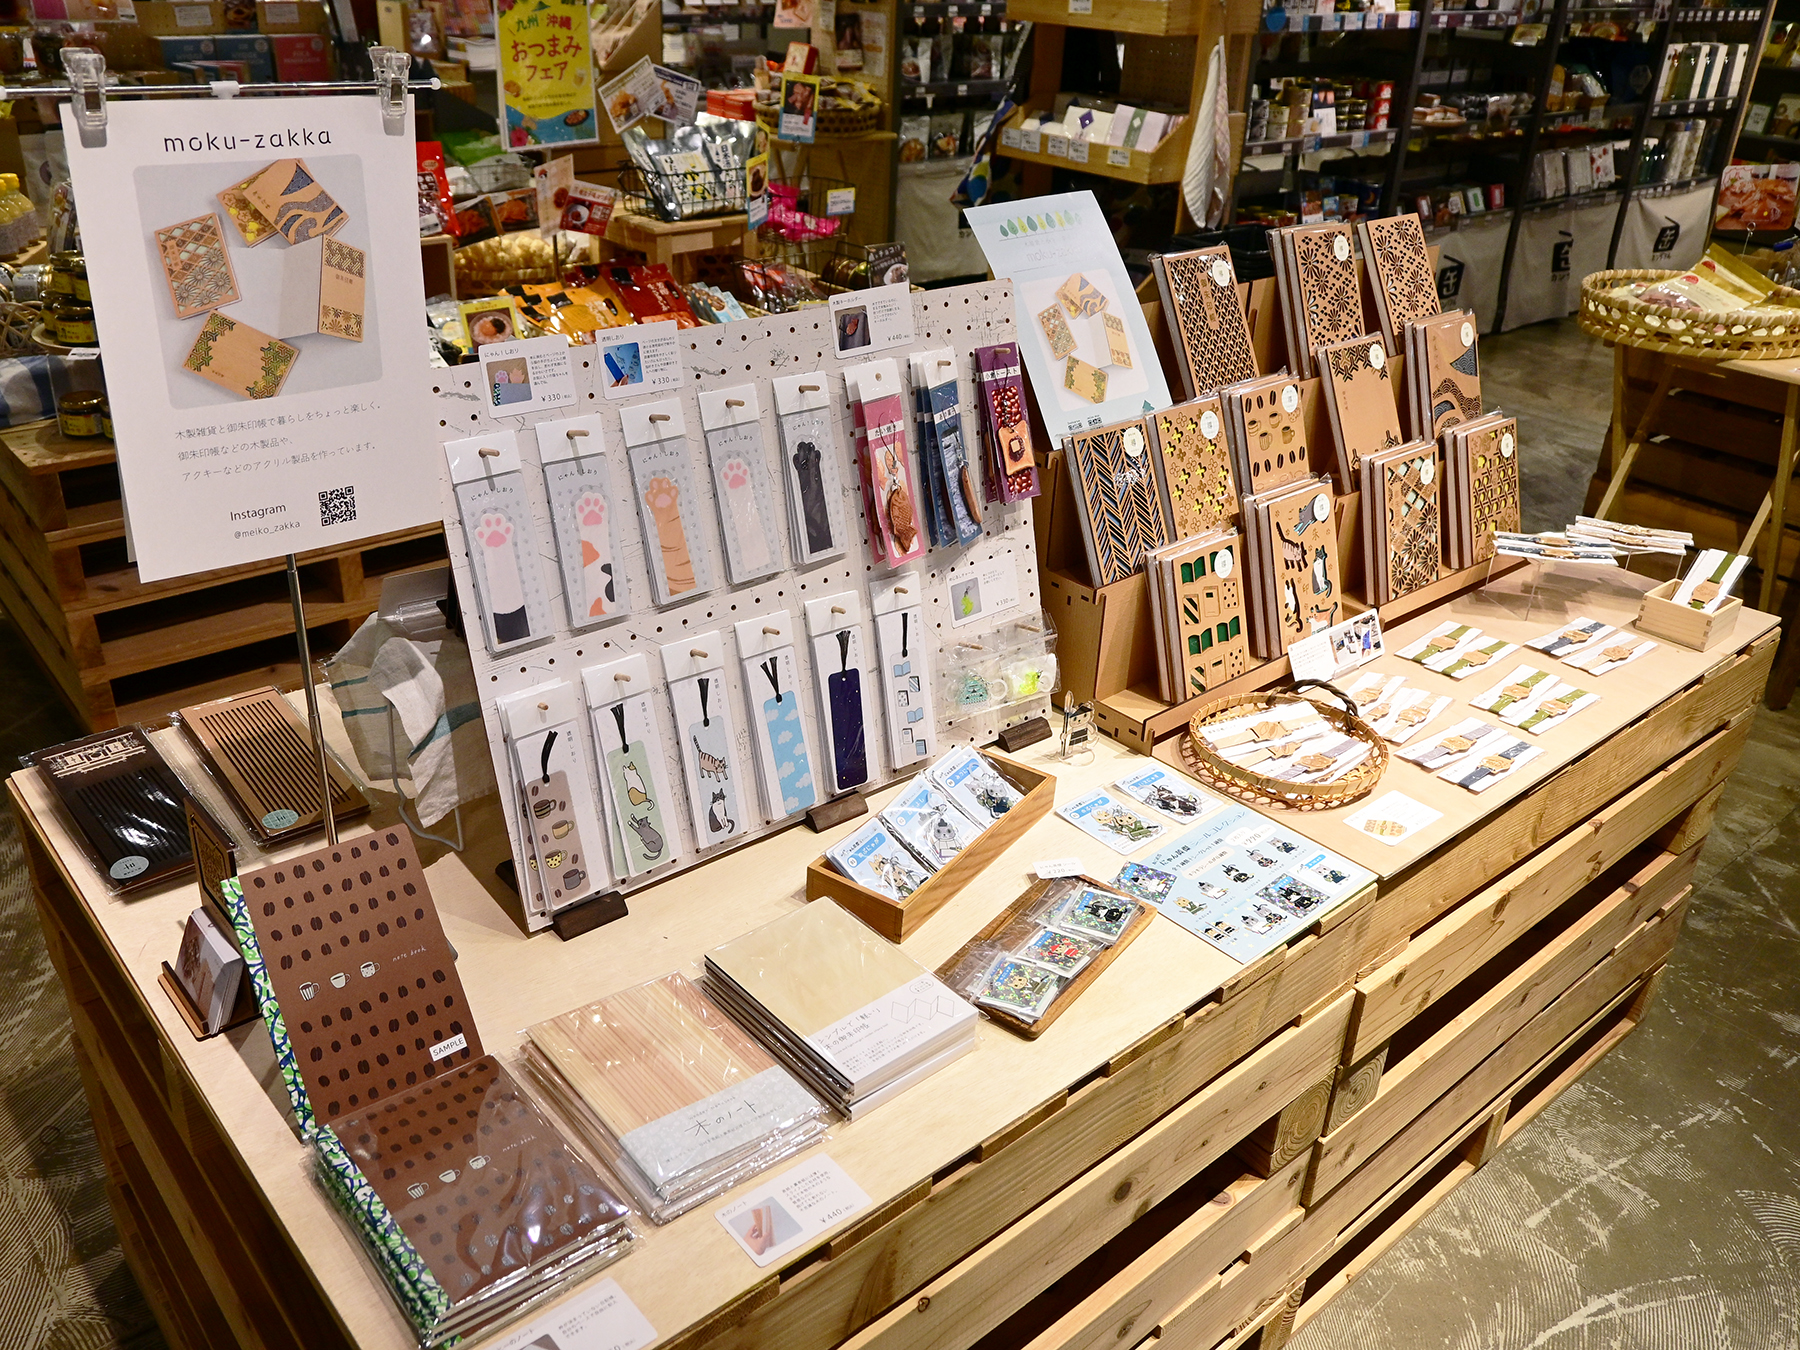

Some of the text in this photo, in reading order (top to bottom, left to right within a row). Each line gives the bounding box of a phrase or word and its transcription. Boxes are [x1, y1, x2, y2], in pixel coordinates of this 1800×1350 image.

[516, 12, 572, 32] 九州 沖縄
[511, 34, 582, 62] おつまみ
[525, 60, 568, 82] フェア
[164, 127, 332, 153] moku-zakka
[483, 347, 520, 358] にゃん！しおり
[174, 400, 382, 441] 木製雑貨と御朱印帳で暮らしをちょっと楽しく。
[177, 436, 294, 462] 御朱印帳などの木製品や、
[181, 441, 376, 482] アクキーなどのアクリル製品を作っています。
[229, 502, 287, 523] Instagram
[233, 520, 301, 540] @meiko_zakka
[1192, 810, 1248, 846] シールコレクション
[392, 946, 427, 962] note book
[433, 1037, 465, 1057] SAMPLE
[684, 1098, 758, 1137] 木のノート
[720, 1200, 748, 1218] 木のノート
[819, 1208, 843, 1224] ¥440
